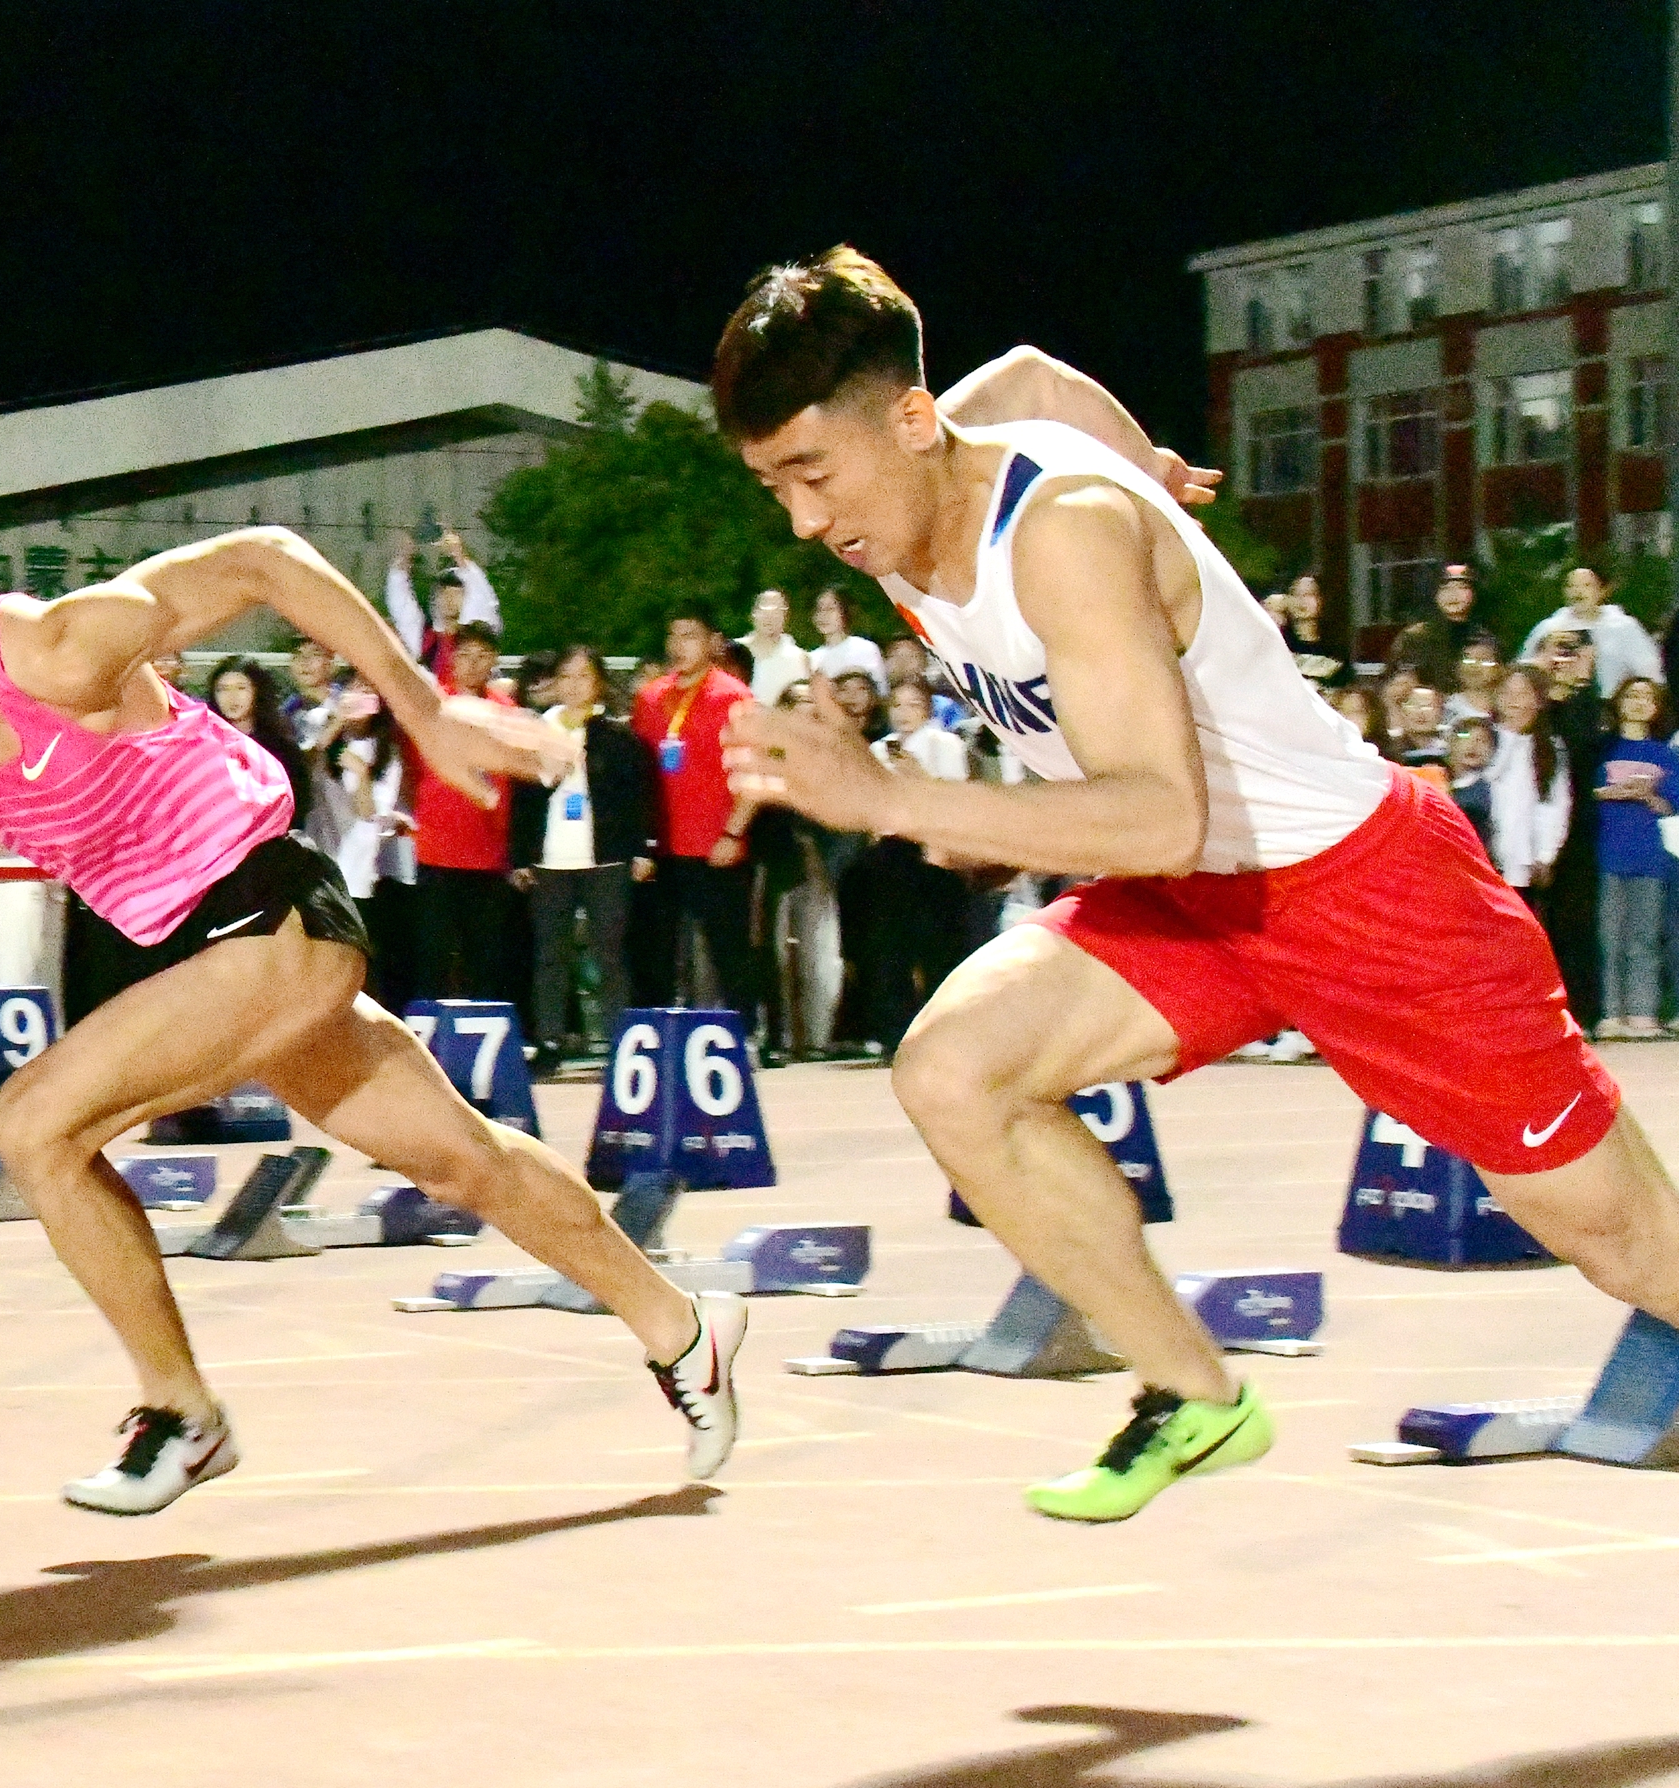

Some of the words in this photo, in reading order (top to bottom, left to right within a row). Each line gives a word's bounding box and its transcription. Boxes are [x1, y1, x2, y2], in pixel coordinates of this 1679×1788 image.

[0, 997, 48, 1068] 9
[454, 1016, 510, 1100] 7
[614, 1024, 660, 1115] 6
[684, 1024, 745, 1116] 6
